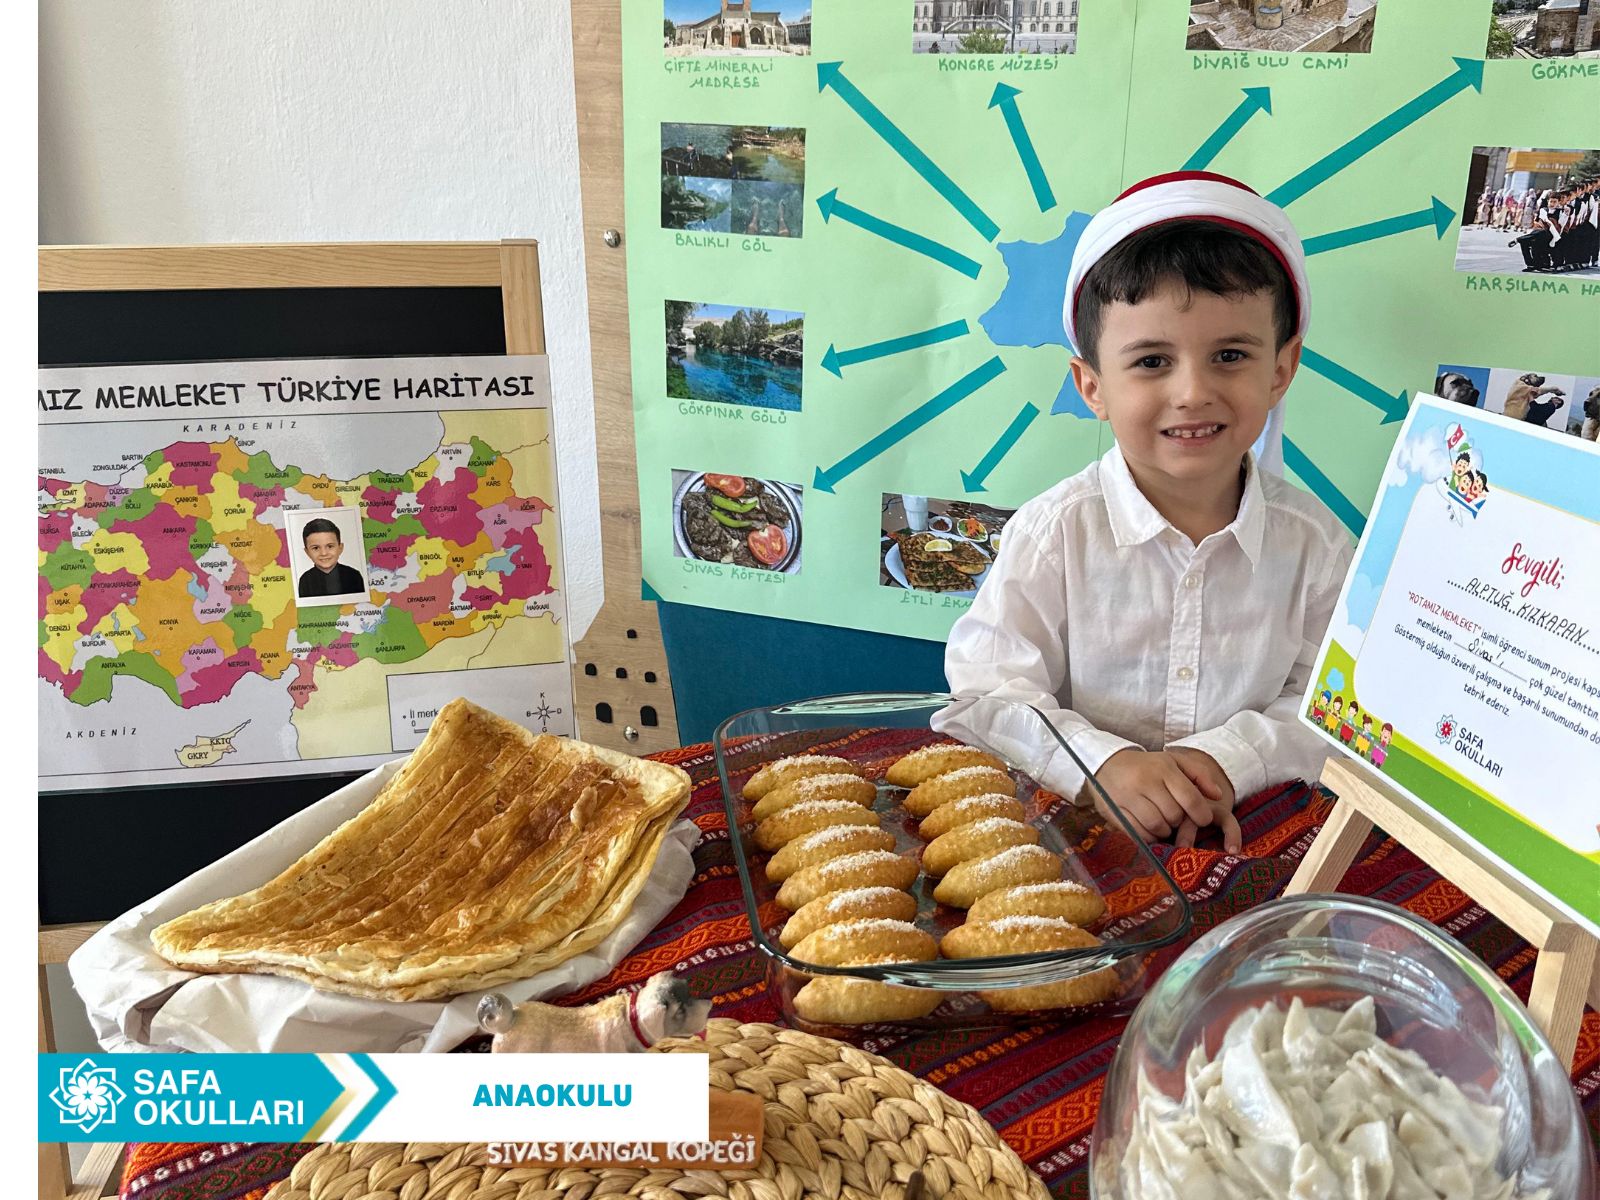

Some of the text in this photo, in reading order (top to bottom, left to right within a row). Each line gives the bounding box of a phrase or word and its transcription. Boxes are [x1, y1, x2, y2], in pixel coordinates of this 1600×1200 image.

[664, 57, 774, 75] ÇİFTE MİNERALİ
[938, 57, 1059, 72] KONGRE MÜZESİ
[1193, 53, 1348, 70] DİVRİĞ ULU CAMİ
[1532, 60, 1599, 80] GÖKME
[690, 76, 760, 89] MEDRESE
[675, 233, 772, 252] BALIKLI GÖL
[1466, 276, 1570, 294] KARŞILAMA
[96, 382, 246, 409] MEMLEKET
[256, 376, 381, 402] TÜRKİYE
[394, 372, 535, 400] HARİTASI
[678, 401, 788, 424] GÖKPINAR GÖLÜ
[183, 420, 297, 432] KARADENİZ
[224, 507, 246, 517] ÇORUM
[682, 559, 724, 578] SİVAS
[1502, 543, 1566, 598] Sevgili;
[900, 591, 933, 606] ETLİ
[1416, 618, 1452, 642] memleketin
[1528, 678, 1544, 691] çok
[1542, 684, 1568, 702] güzel
[1481, 629, 1499, 645] isimli
[1498, 637, 1527, 659] öğrenci
[1526, 654, 1551, 672] sunum
[1550, 666, 1582, 688] projesi
[1394, 624, 1426, 651] Göstermiş
[1426, 642, 1451, 661] olduğun
[1451, 654, 1477, 675] özverili
[1476, 670, 1502, 690] çalışma
[1503, 685, 1512, 695] ve
[1512, 686, 1540, 712] başarılı
[1541, 706, 1589, 738] sunumundan
[1464, 683, 1510, 717] tebrik ederiz.
[66, 726, 137, 739] AKDENİZ
[1458, 727, 1484, 751] SAFA
[187, 752, 208, 760] GKRY
[1454, 739, 1504, 778] OKULLARI
[563, 1142, 660, 1163] KANGAL
